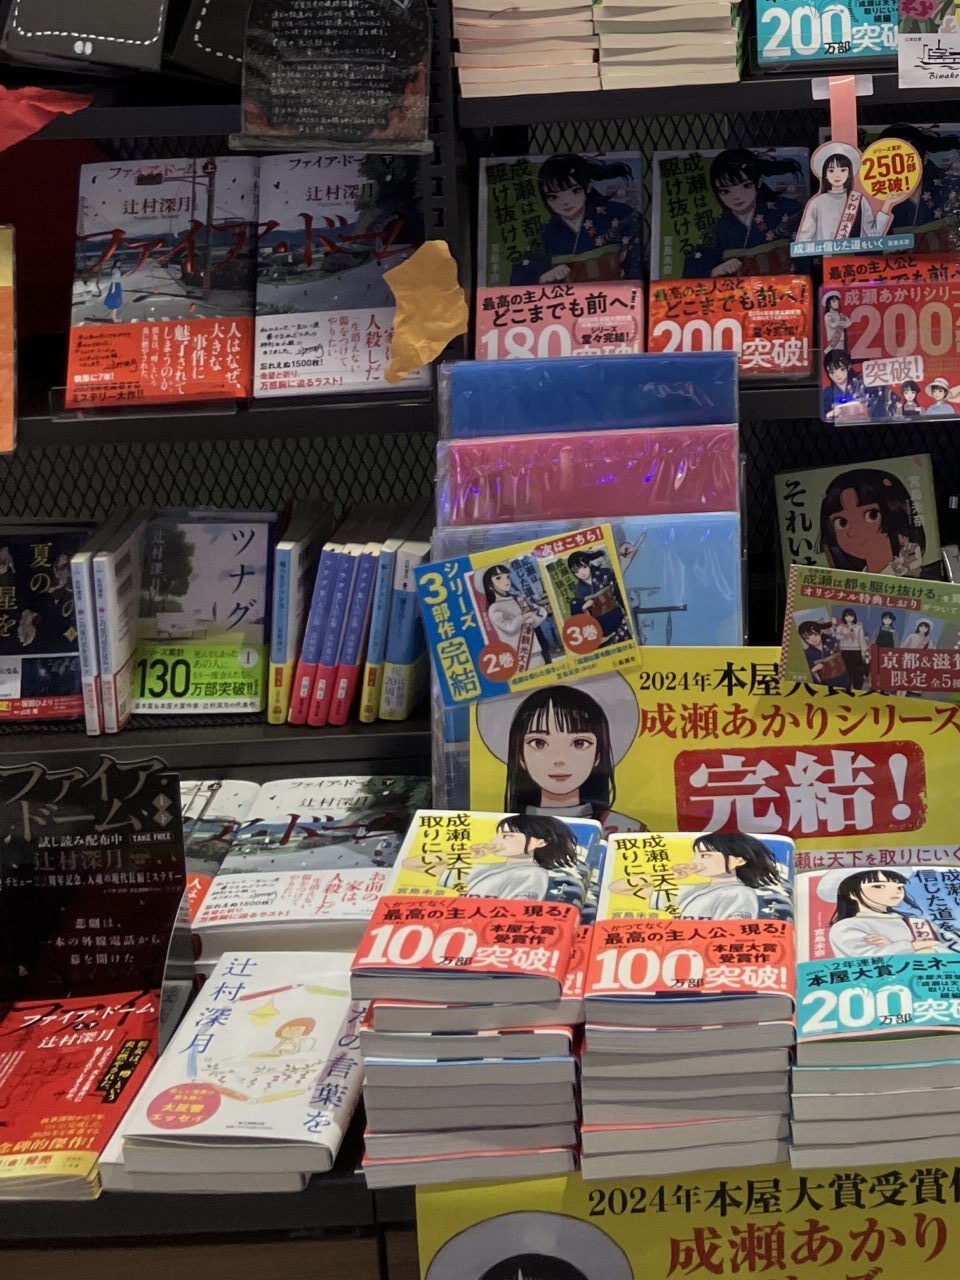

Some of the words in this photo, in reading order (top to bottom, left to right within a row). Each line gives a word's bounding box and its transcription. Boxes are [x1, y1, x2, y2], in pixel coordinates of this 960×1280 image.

[122, 198, 192, 216] 辻村深月
[226, 529, 257, 631] ツナグ
[137, 658, 191, 699] 130
[686, 749, 911, 835] 完結!
[132, 833, 151, 842] TAKE
[153, 832, 172, 841] FREE
[419, 815, 443, 878] 取りにいく
[446, 813, 472, 894] 成瀬は天下を
[180, 956, 258, 1054] 辻村深月
[37, 1028, 115, 1049] 辻村深月
